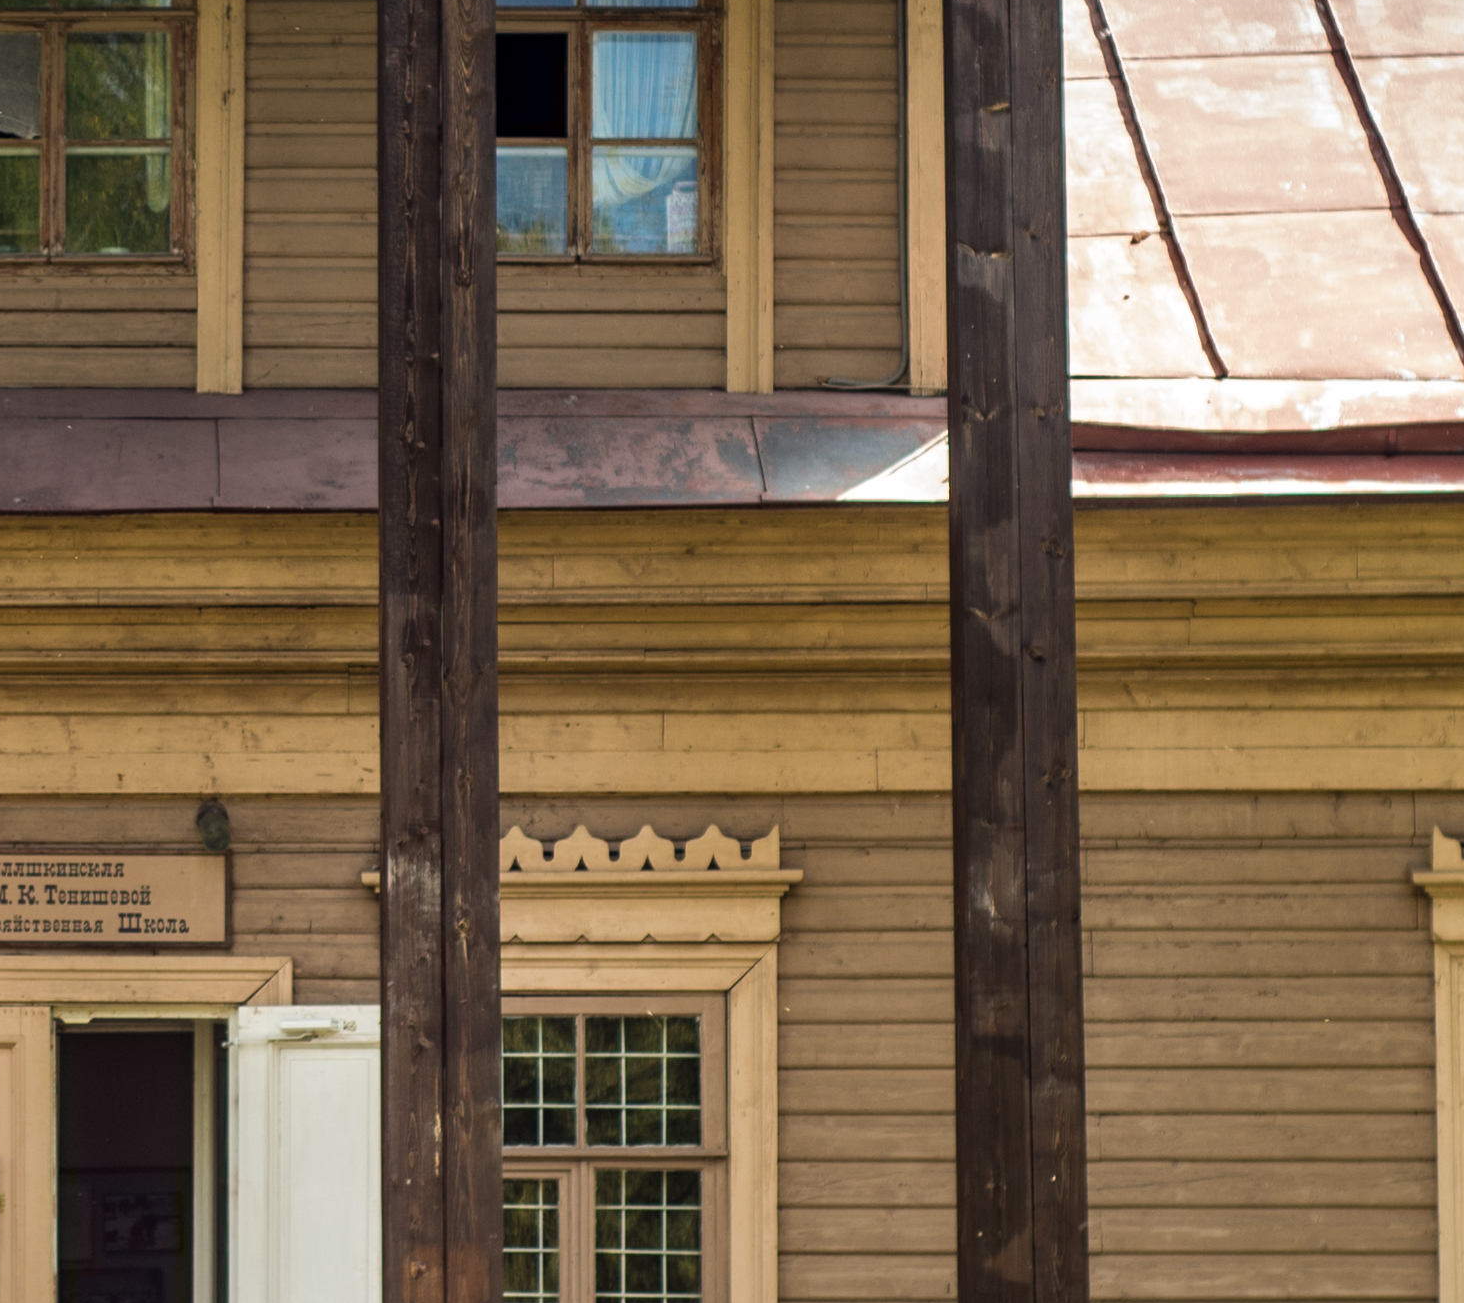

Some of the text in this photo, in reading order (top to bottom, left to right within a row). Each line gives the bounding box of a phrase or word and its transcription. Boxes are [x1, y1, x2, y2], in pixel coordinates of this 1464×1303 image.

[18, 884, 40, 905] К.
[44, 884, 152, 906] Тенишевой
[117, 912, 190, 934] Школа
